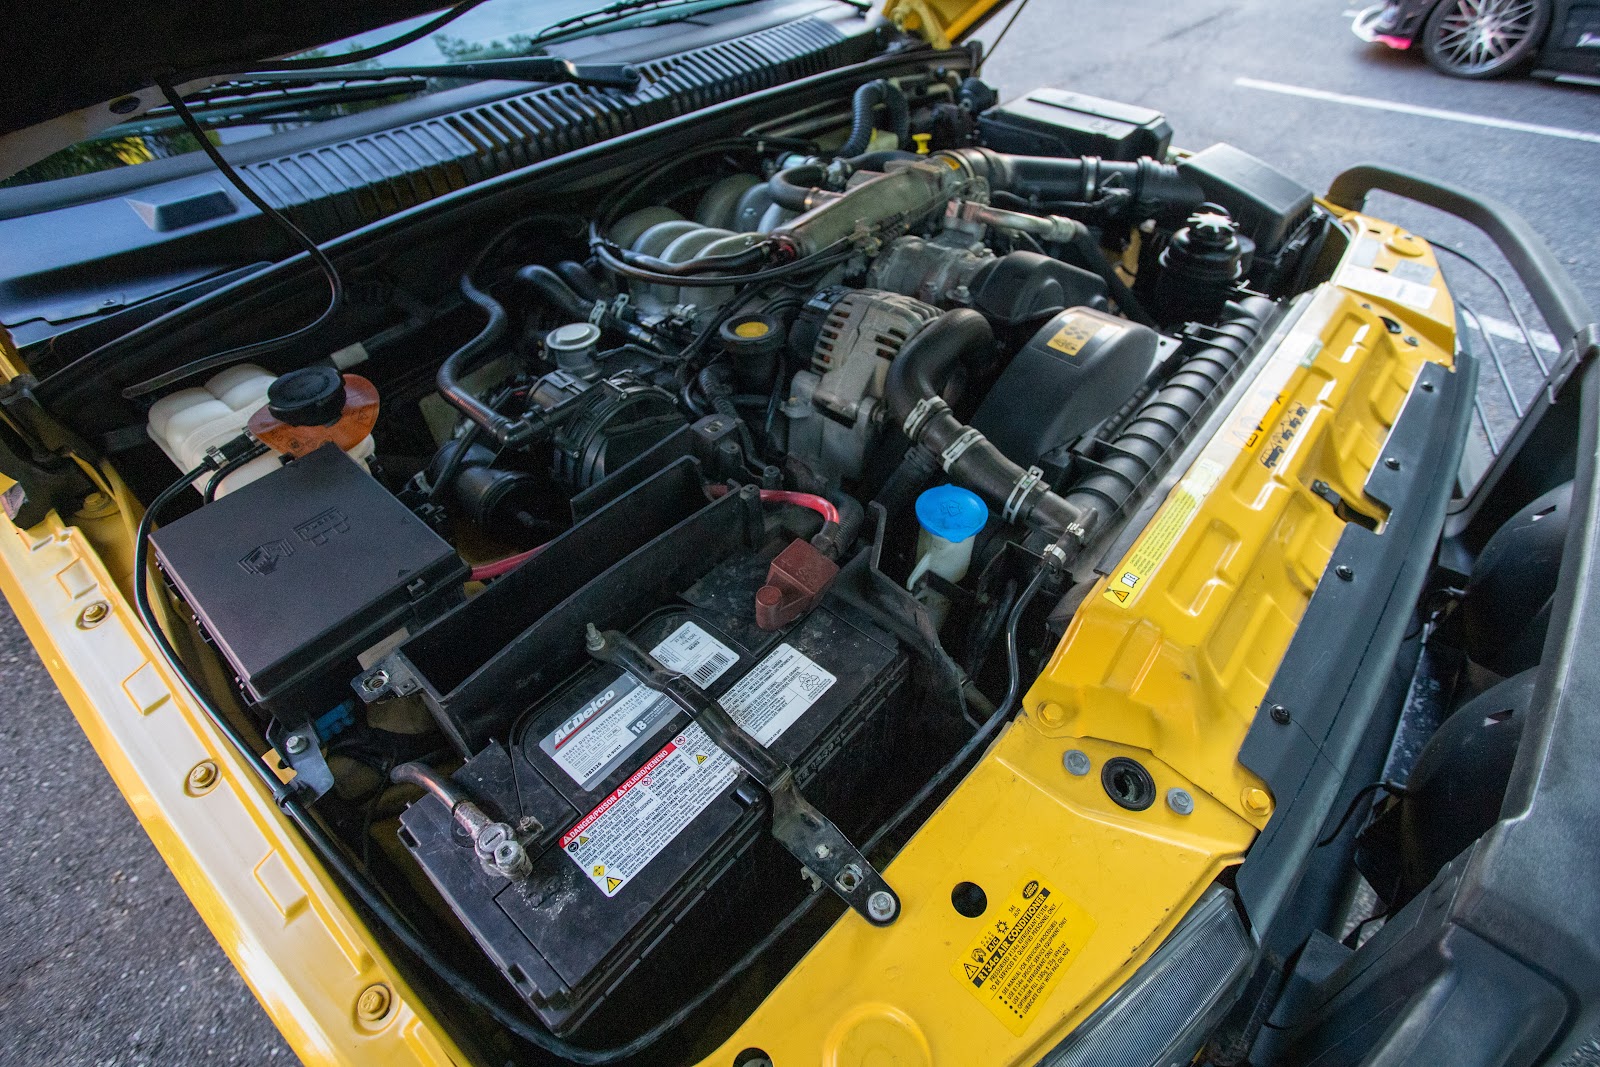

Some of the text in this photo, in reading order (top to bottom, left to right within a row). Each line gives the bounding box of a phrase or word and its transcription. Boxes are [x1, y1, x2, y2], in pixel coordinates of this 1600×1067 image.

[554, 690, 616, 744] ACDelco
[630, 720, 648, 733] 18
[568, 749, 668, 838] DANGER/POISON PELIGRO/VENENO
[977, 892, 1046, 982] R134a AIR CONDITIONER
[987, 936, 999, 951] A/C
